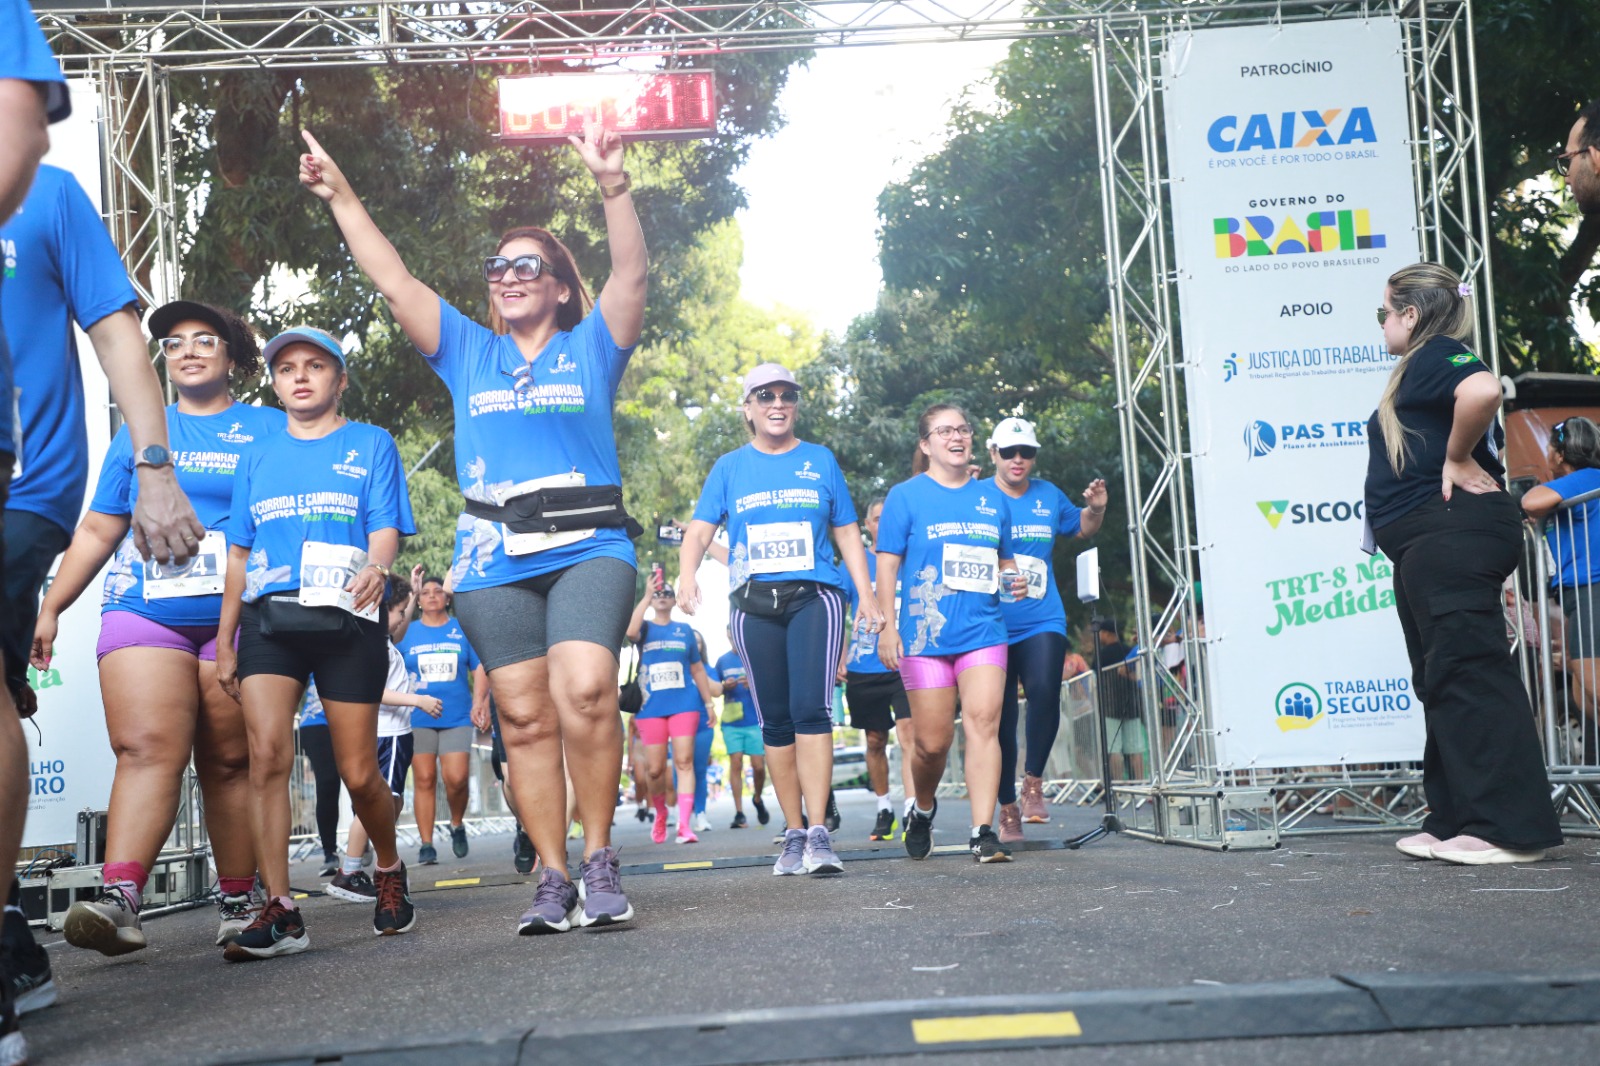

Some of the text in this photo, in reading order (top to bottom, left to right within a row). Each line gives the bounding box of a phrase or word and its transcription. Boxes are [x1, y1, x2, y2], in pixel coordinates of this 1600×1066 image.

[1241, 60, 1333, 78] PATROCÍNIO
[1207, 107, 1378, 153] CAIXA
[1208, 160, 1214, 168] É
[1217, 159, 1236, 168] POR
[1272, 155, 1278, 165] É
[1281, 154, 1300, 164] POR
[1303, 153, 1332, 162] TODO
[1335, 152, 1344, 161] O
[1249, 194, 1345, 208] GOVERNO DO
[1213, 208, 1387, 259] BRASIL
[1225, 257, 1380, 273] DO LADO DO POVO BRASILEIRO
[1280, 302, 1333, 318] APOIO
[1248, 350, 1300, 370] JUSTIÇA
[1303, 349, 1321, 367] DO
[476, 390, 515, 406] CORRIDA
[479, 402, 516, 414] JUSTIÇA
[518, 400, 533, 409] DO
[534, 397, 584, 406] TRABALHO
[1282, 424, 1325, 441] PAS
[180, 452, 188, 460] E
[256, 496, 296, 515] CORRIDA
[298, 494, 304, 507] E
[306, 492, 359, 509] CAMINHADA
[743, 491, 771, 505] CORRIDA
[772, 490, 778, 499] E
[778, 488, 819, 499] CAMINHADA
[262, 508, 297, 522] JUSTIÇA
[298, 508, 311, 516] DO
[312, 506, 357, 517] TRABALHO
[758, 540, 798, 559] 1391
[952, 561, 988, 580] 1392
[1265, 566, 1348, 601] TRT-8
[1266, 584, 1397, 636] Medida
[1324, 678, 1409, 695] TRABALHO
[1327, 694, 1411, 715] SEGURO
